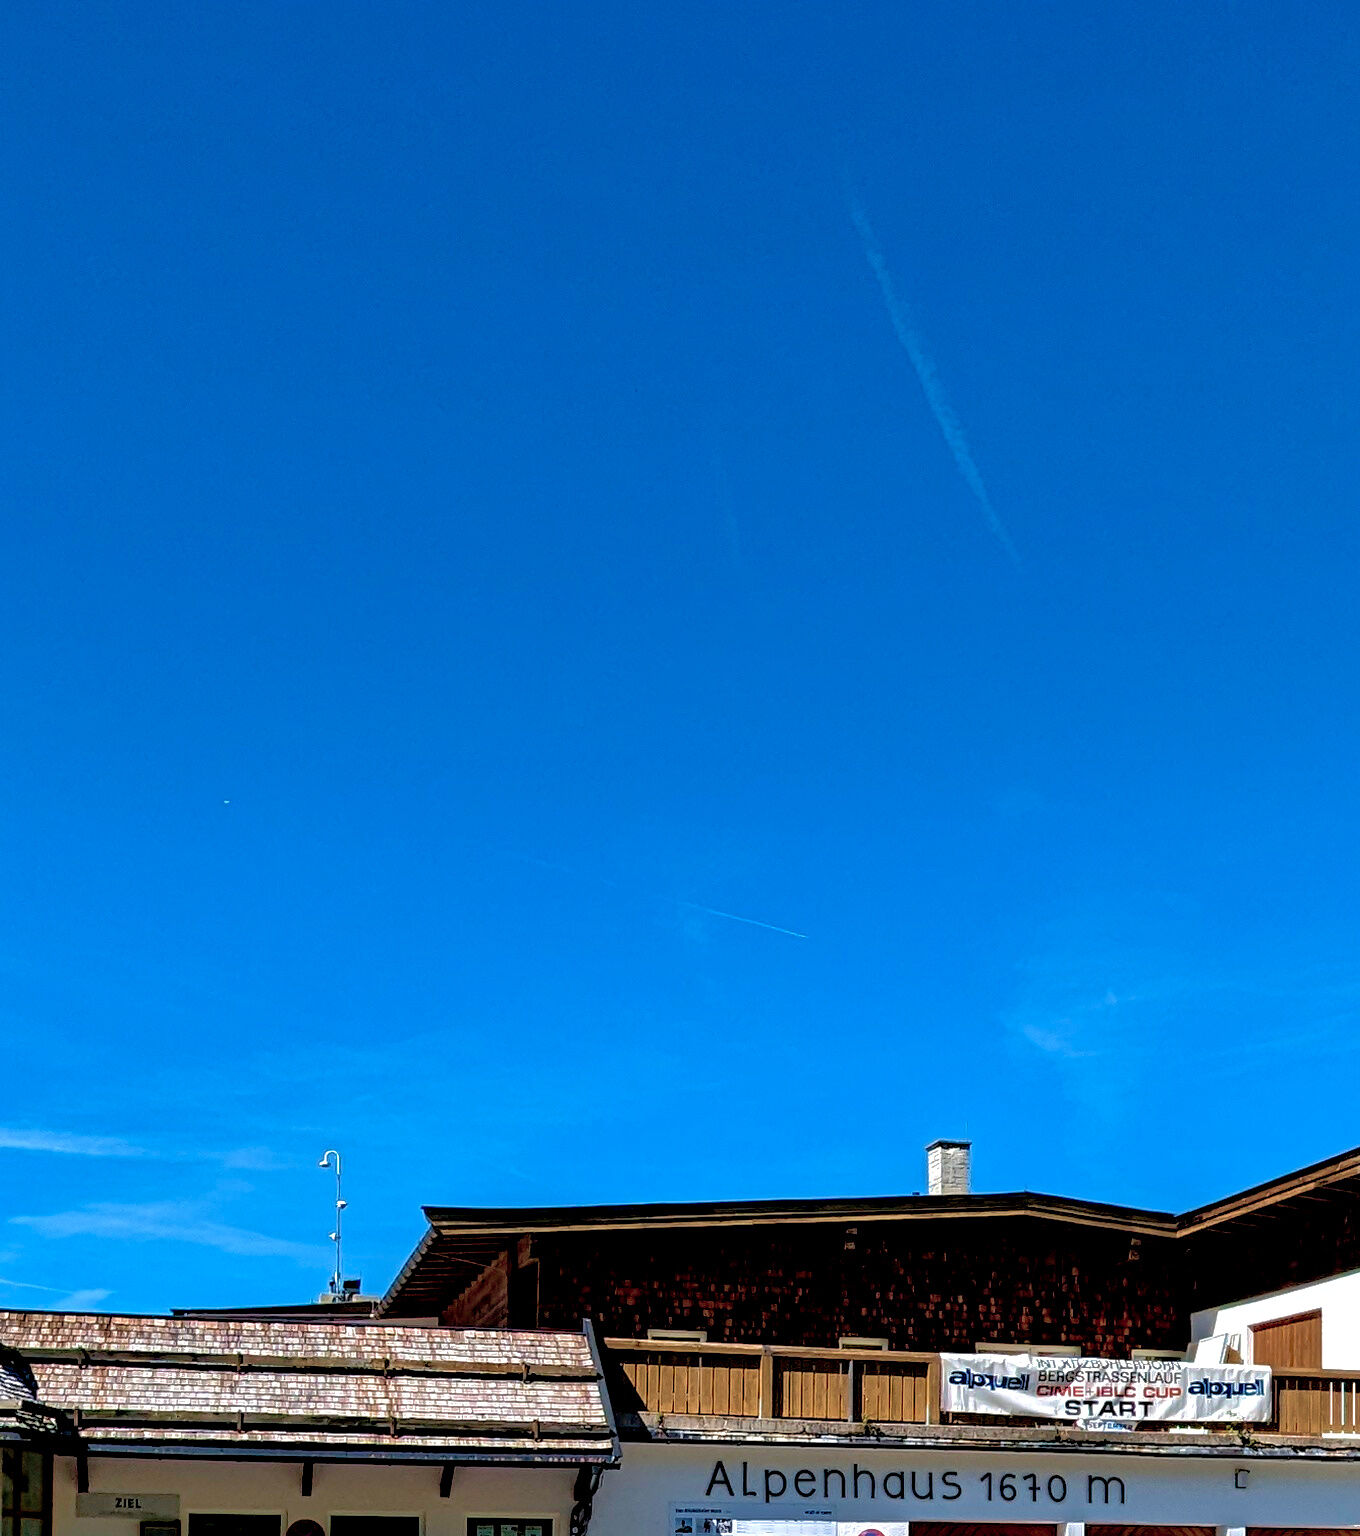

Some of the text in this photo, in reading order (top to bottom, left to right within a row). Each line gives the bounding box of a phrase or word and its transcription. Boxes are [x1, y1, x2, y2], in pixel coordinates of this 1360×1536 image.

[1038, 1370, 1182, 1384] BERGSTRASSENLAUF
[1143, 1386, 1182, 1399] CUP
[1064, 1399, 1154, 1417] START
[705, 1460, 1125, 1504] Alpenhaus 1670 m
[115, 1498, 142, 1509] ZIEL
